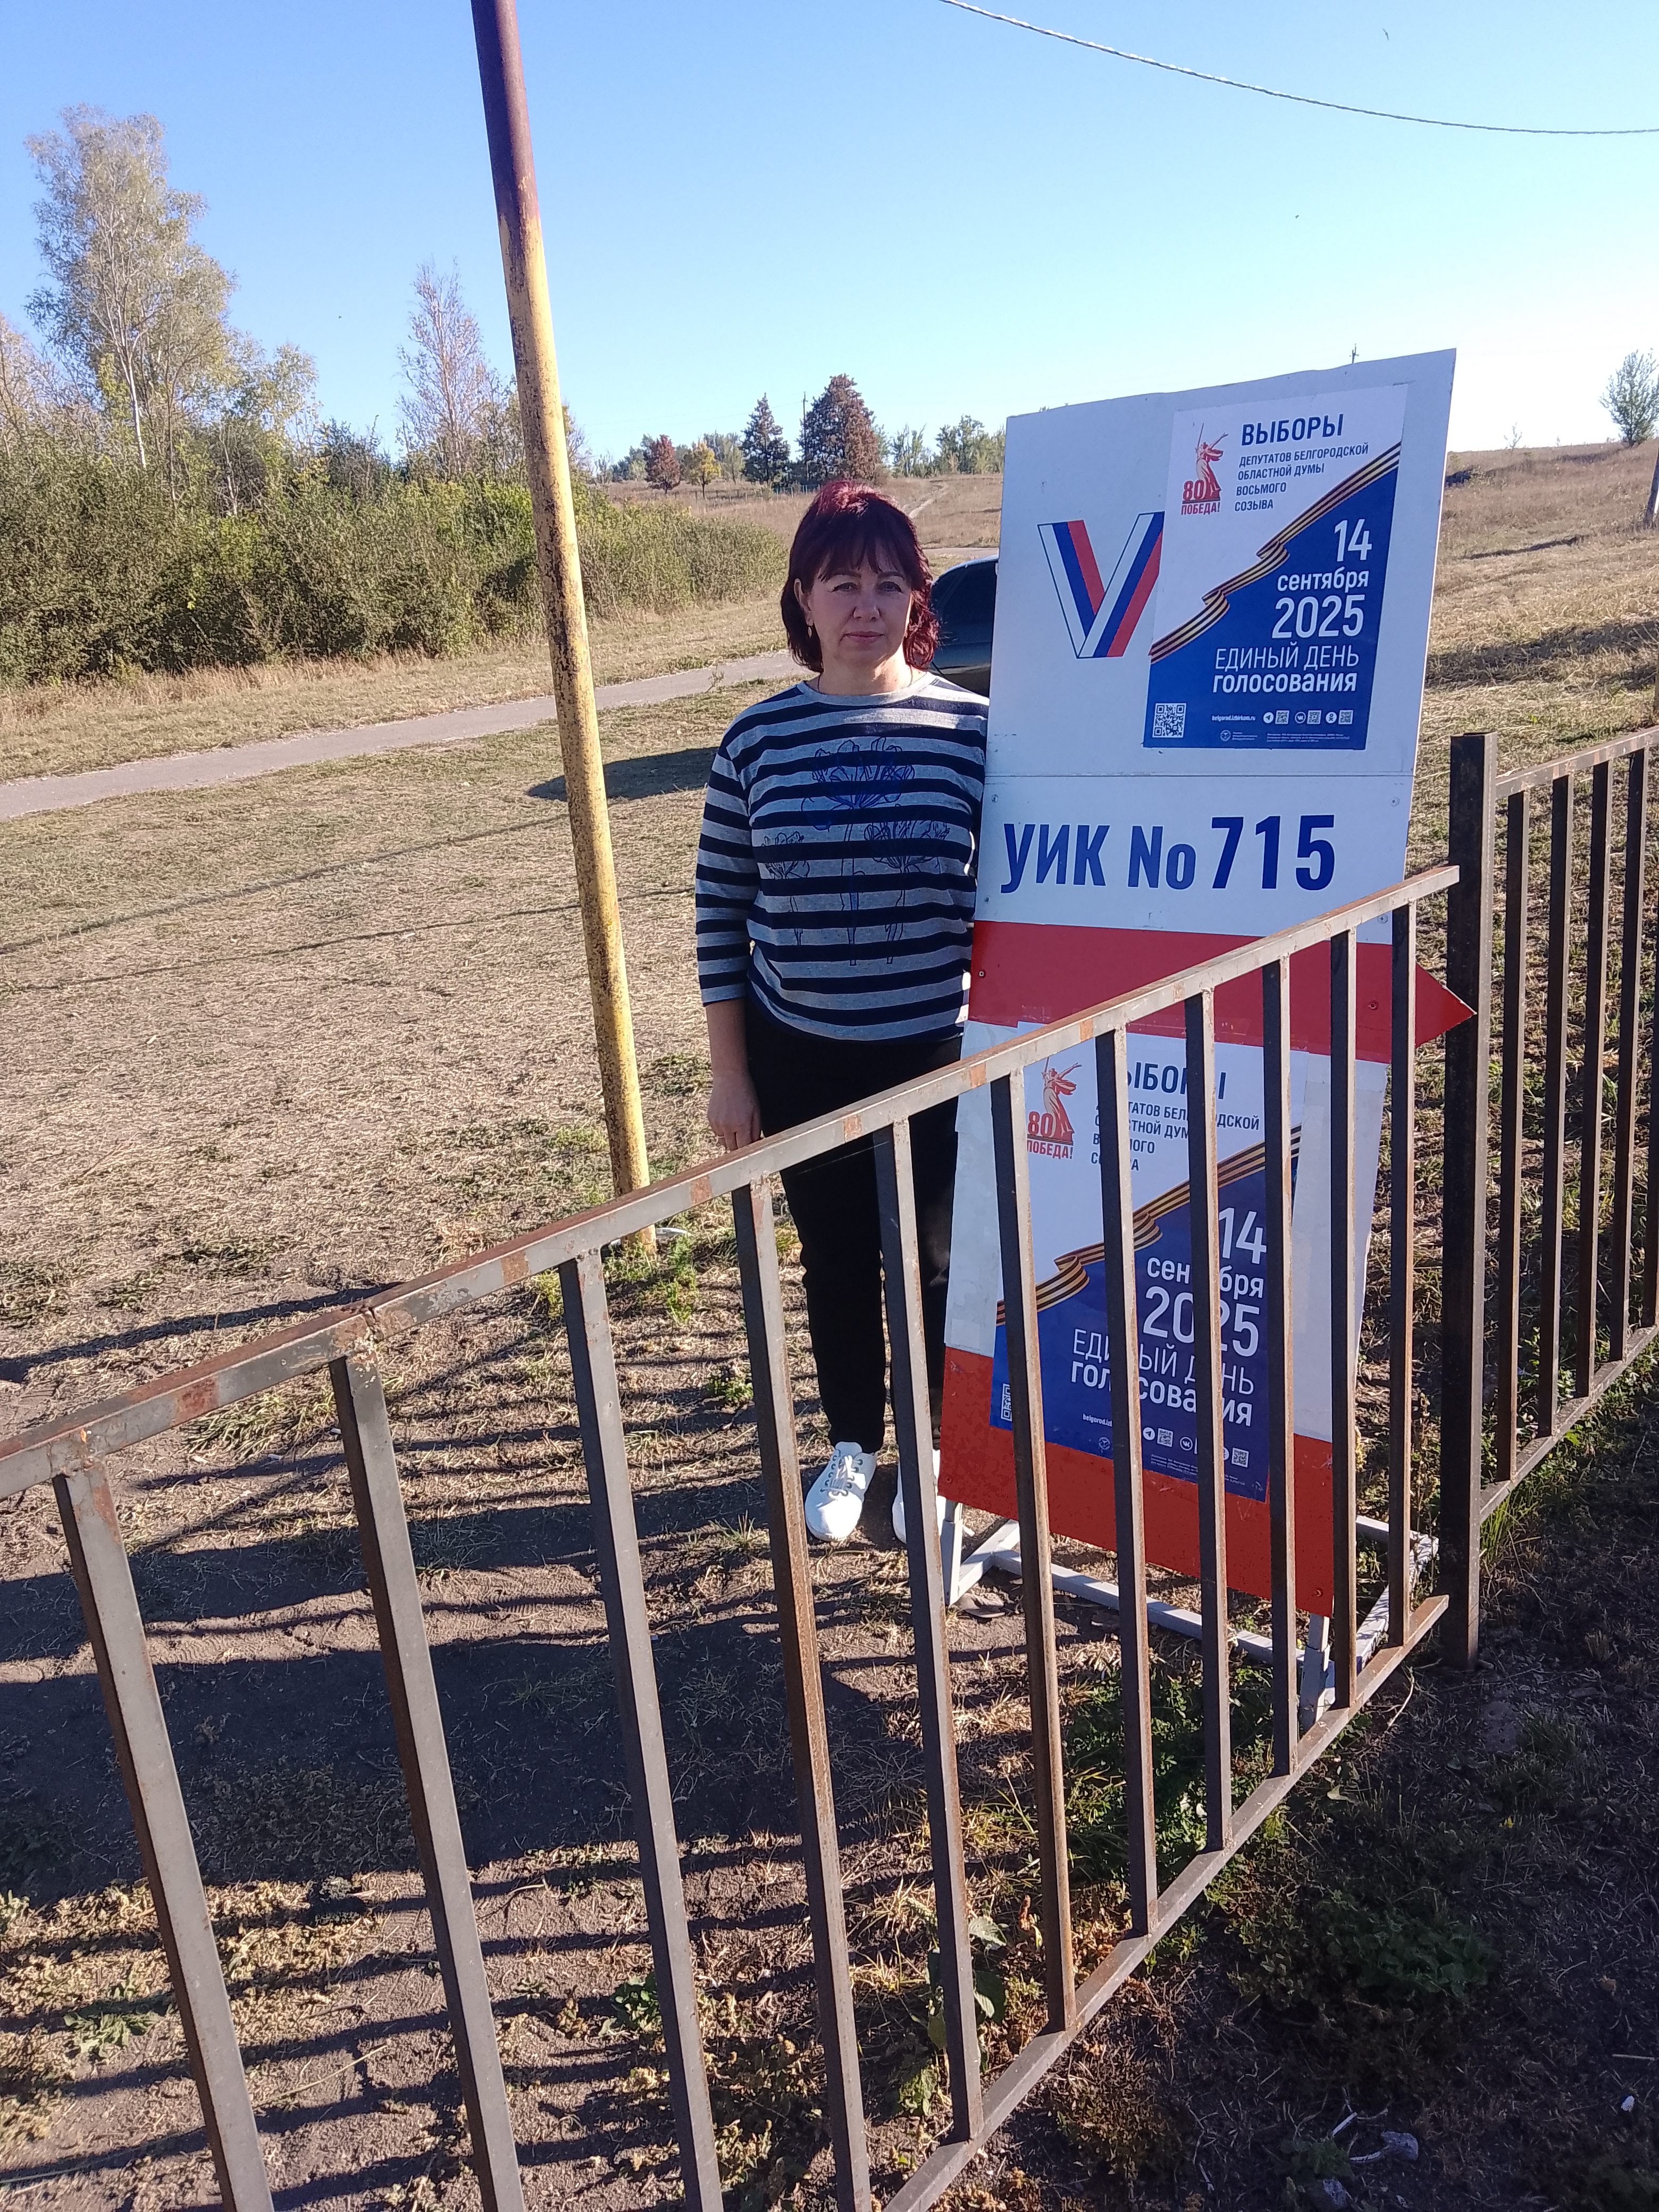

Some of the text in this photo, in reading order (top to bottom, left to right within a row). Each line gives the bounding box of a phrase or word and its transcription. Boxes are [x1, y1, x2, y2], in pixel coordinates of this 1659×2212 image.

[1241, 414, 1344, 446] ВЫБОРЫ
[1239, 443, 1369, 467] ДЕПУТАТОВ БЕЛГОРОДСКОЙ
[1237, 463, 1325, 481] ОБЛАСТНОЙ ДУМЫ
[1182, 480, 1205, 501] 80
[1236, 482, 1287, 496] ВОСЬМОГО
[1181, 502, 1220, 516] ПОБЕДА!
[1234, 499, 1274, 512] СОЗЫВА
[1334, 519, 1372, 562] 14
[1277, 567, 1369, 593] сентября
[1271, 594, 1365, 639] 2025
[1215, 641, 1359, 673] ЕДИНЫЙ ДЕНЬ
[1000, 822, 1111, 894] УИК
[1211, 814, 1336, 891] 715
[1028, 1111, 1054, 1137] 80
[1163, 1106, 1260, 1131] БЕЛДСКОЙ
[1164, 1125, 1189, 1139] ДУМ
[1027, 1139, 1074, 1160] ПОБЕДА!
[1219, 1207, 1267, 1264] 14
[1147, 1258, 1264, 1300] сенбря
[1073, 1328, 1177, 1377] ЕДЫЙ
